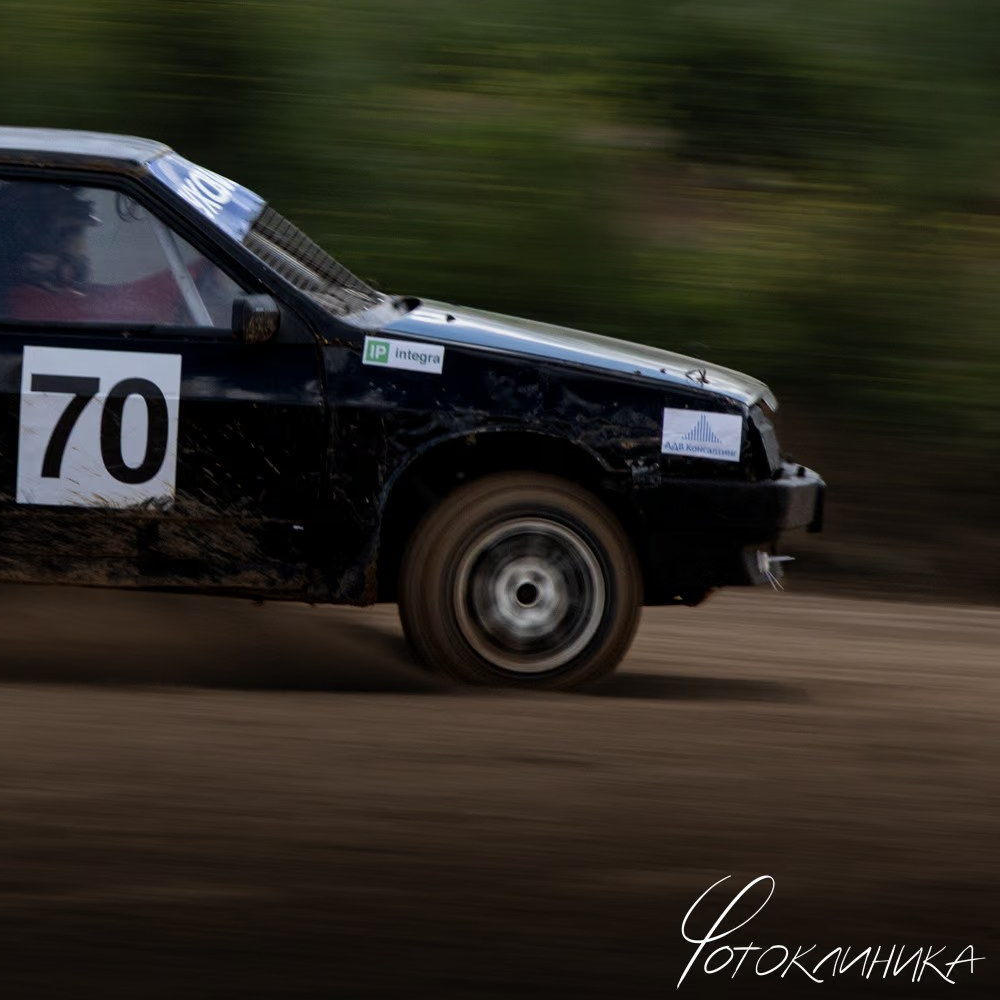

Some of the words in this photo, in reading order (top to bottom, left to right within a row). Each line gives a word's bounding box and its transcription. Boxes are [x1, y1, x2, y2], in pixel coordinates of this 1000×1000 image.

[369, 343, 387, 360] IP
[395, 347, 441, 365] integra
[30, 373, 169, 485] 70
